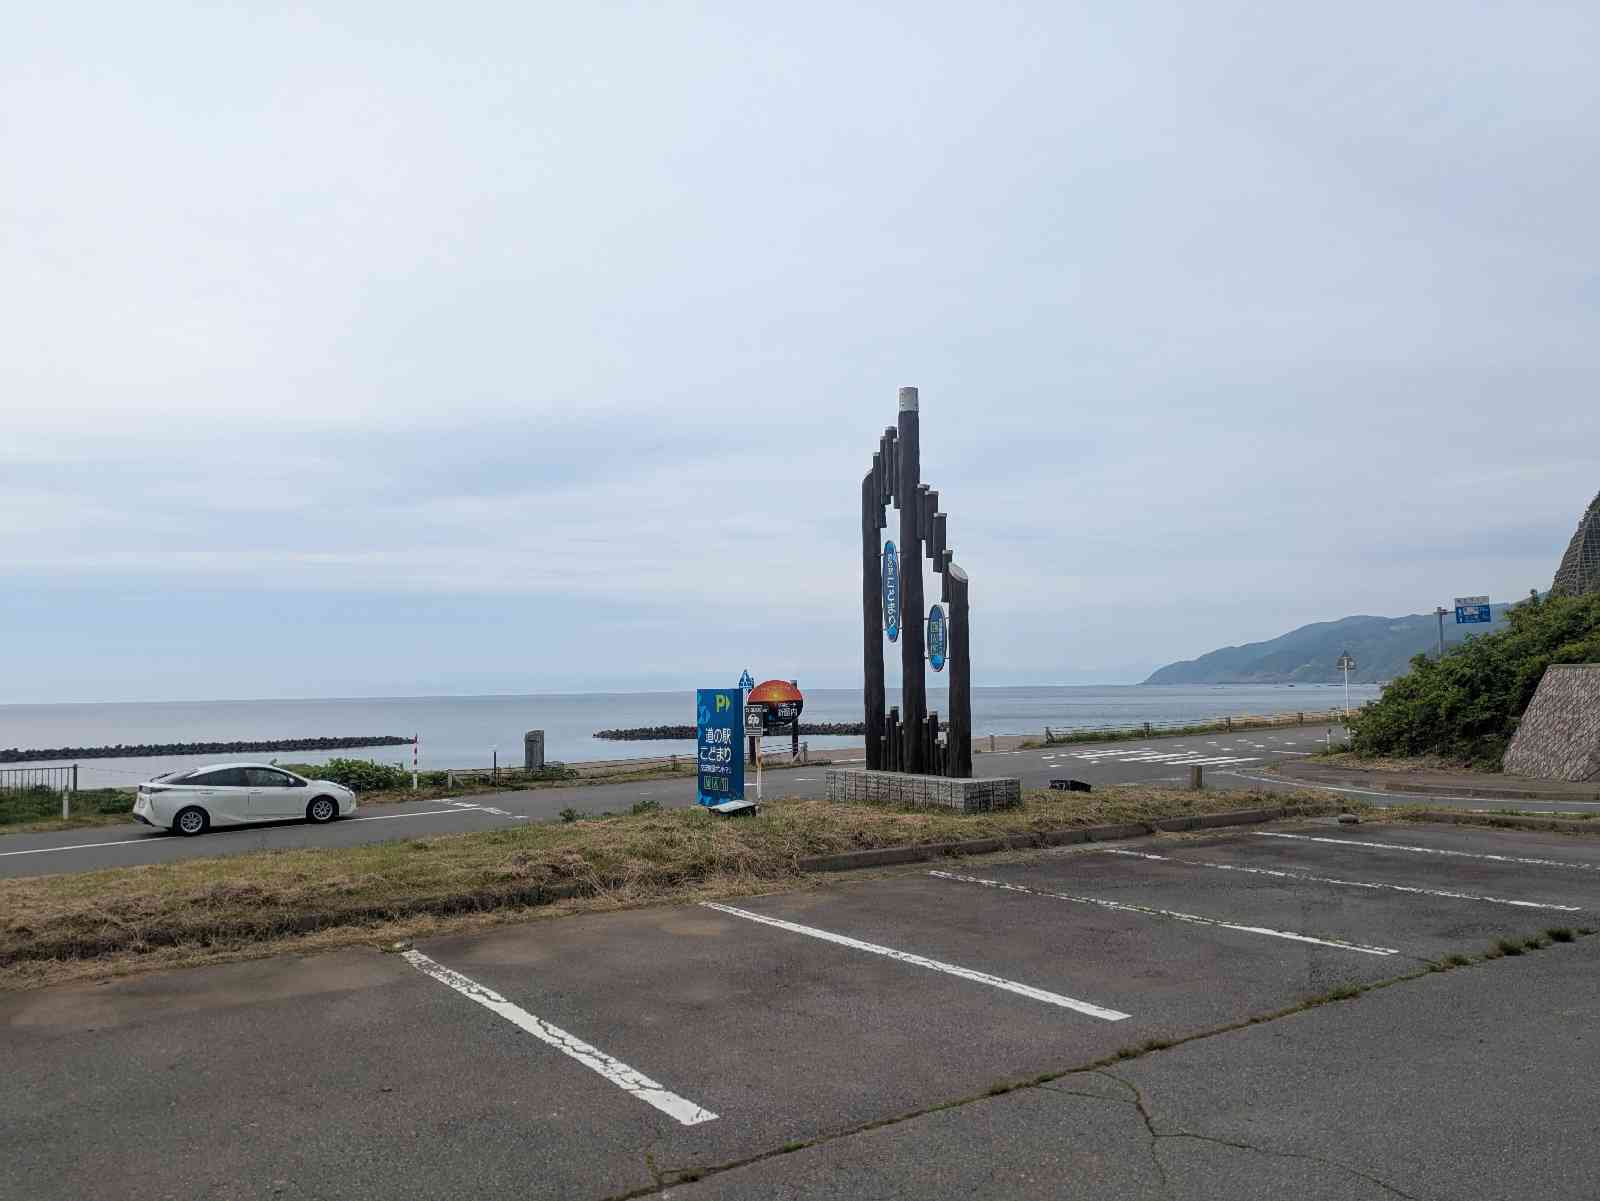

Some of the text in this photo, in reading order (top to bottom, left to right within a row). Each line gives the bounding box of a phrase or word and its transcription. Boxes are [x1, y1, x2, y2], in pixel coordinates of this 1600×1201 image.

[705, 727, 732, 744] 道の駅
[700, 746, 732, 763] こどまり
